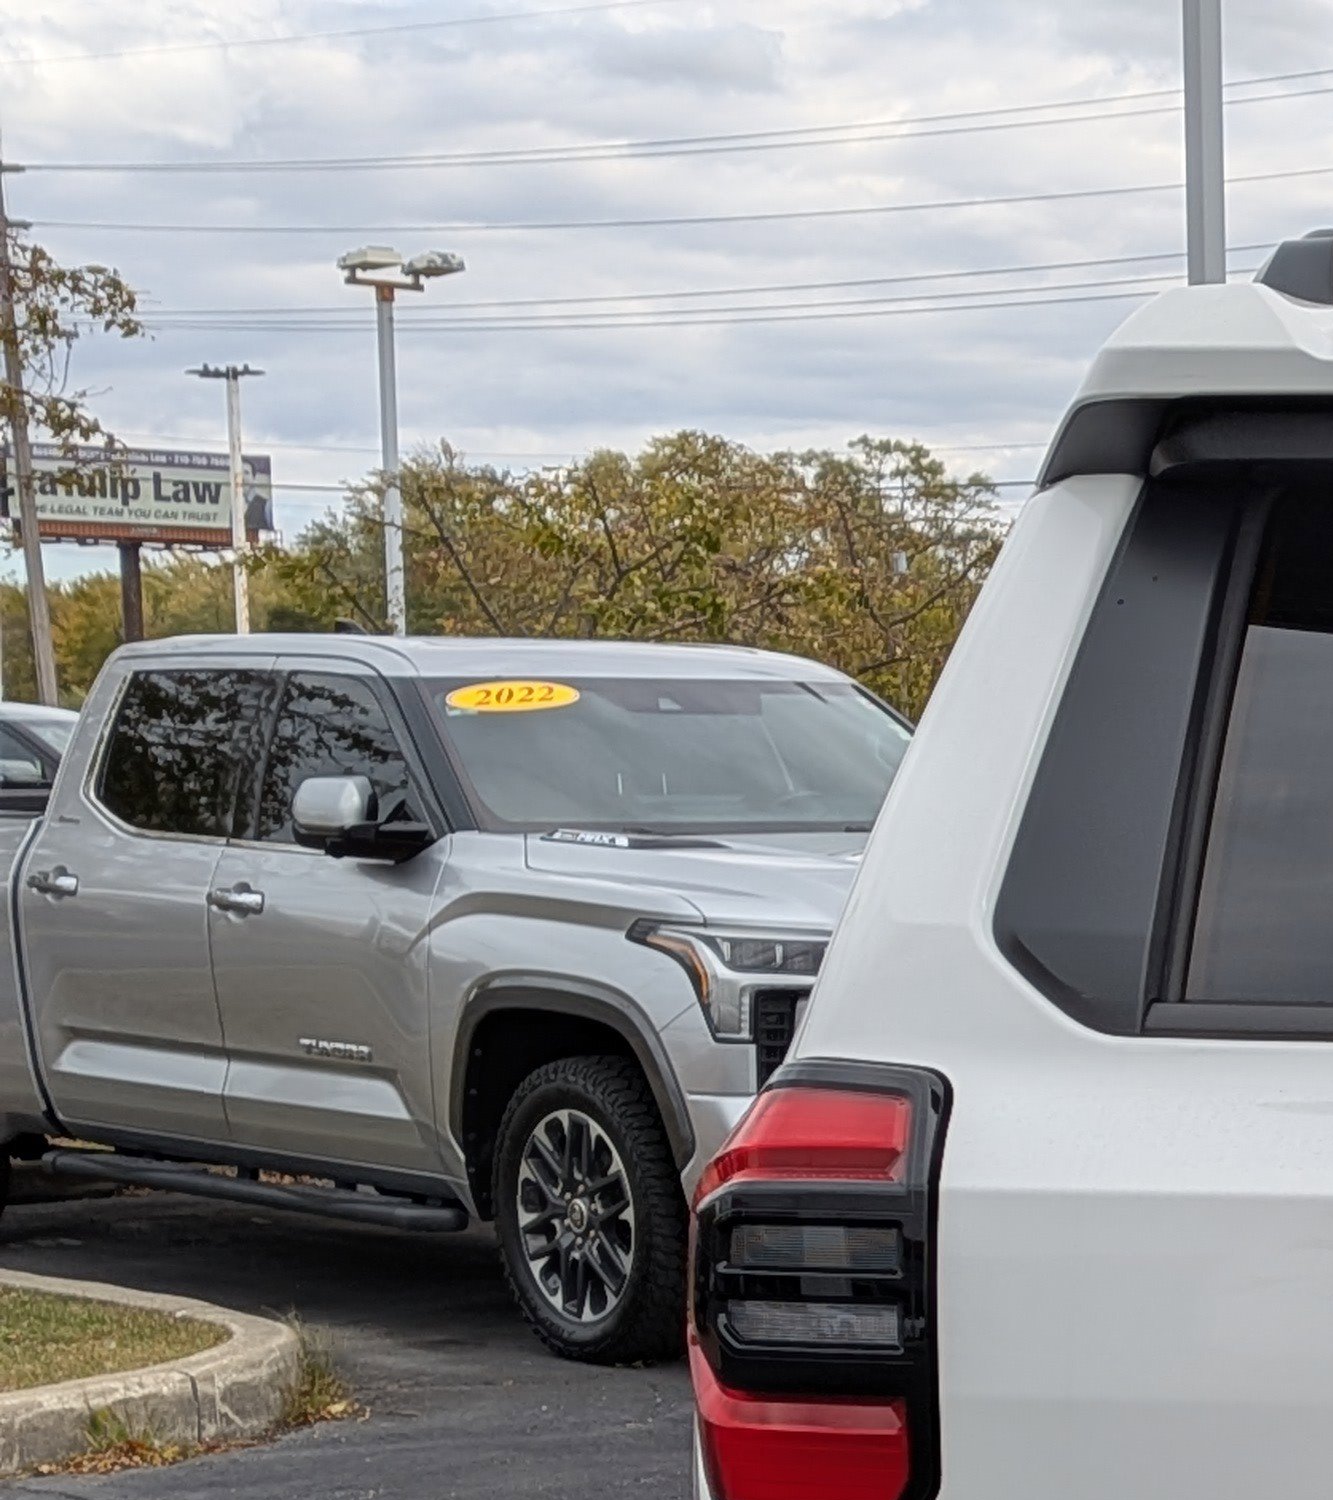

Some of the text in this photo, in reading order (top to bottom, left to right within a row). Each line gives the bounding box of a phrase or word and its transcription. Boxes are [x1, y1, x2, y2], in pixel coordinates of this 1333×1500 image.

[153, 471, 224, 504] Law
[50, 503, 88, 516] LEGAL
[93, 505, 123, 518] TEAM
[127, 507, 151, 519] YOU
[154, 509, 178, 521] CAN
[182, 510, 218, 523] TRUST
[474, 685, 555, 707] 2022
